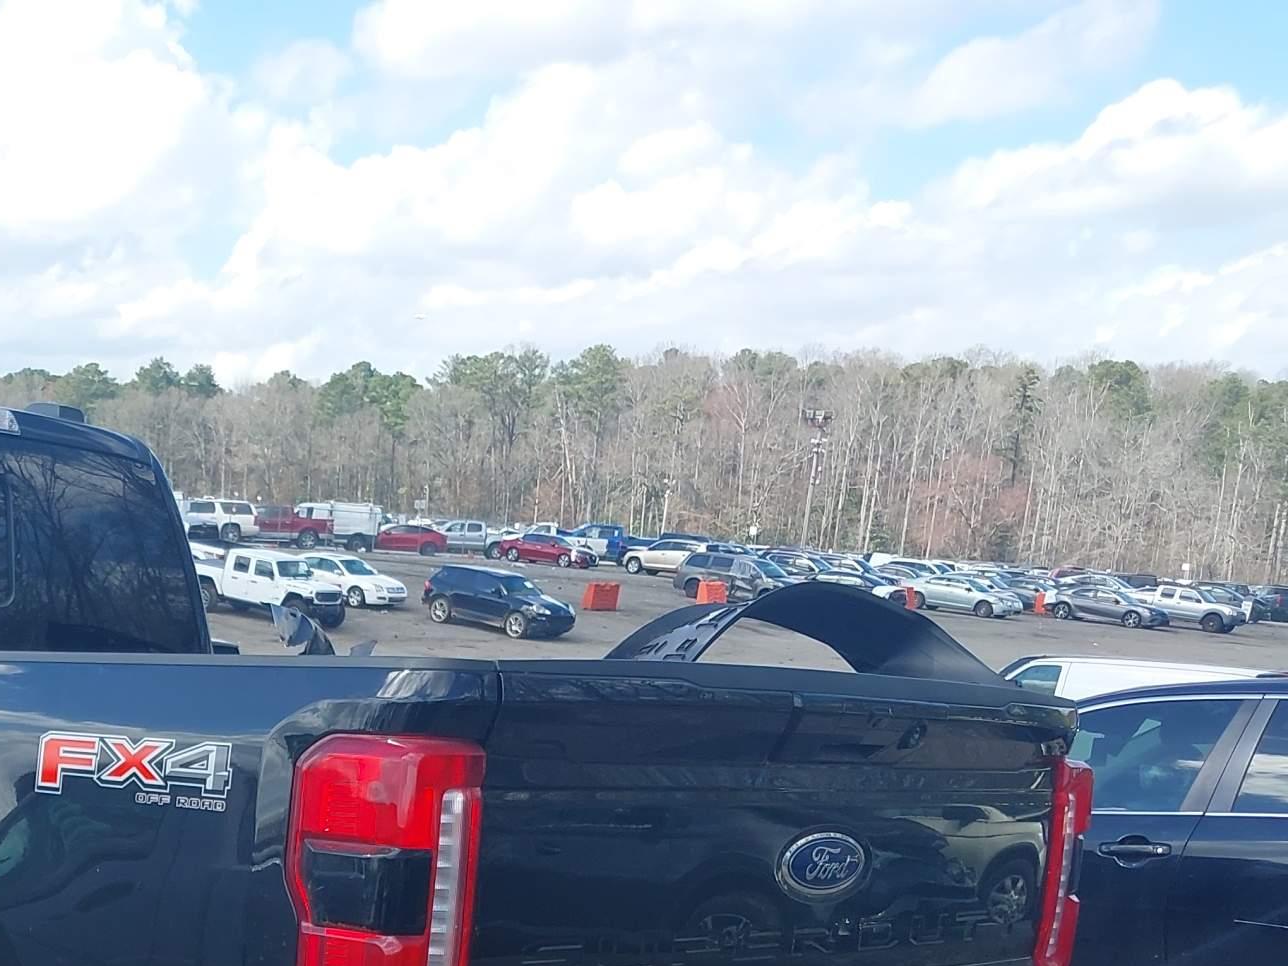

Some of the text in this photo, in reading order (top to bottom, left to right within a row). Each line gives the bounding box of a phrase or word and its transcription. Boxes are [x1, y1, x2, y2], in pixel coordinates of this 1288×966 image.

[35, 731, 232, 798] FX4
[135, 792, 226, 812] OFF ROAD
[805, 846, 851, 880] Ford
